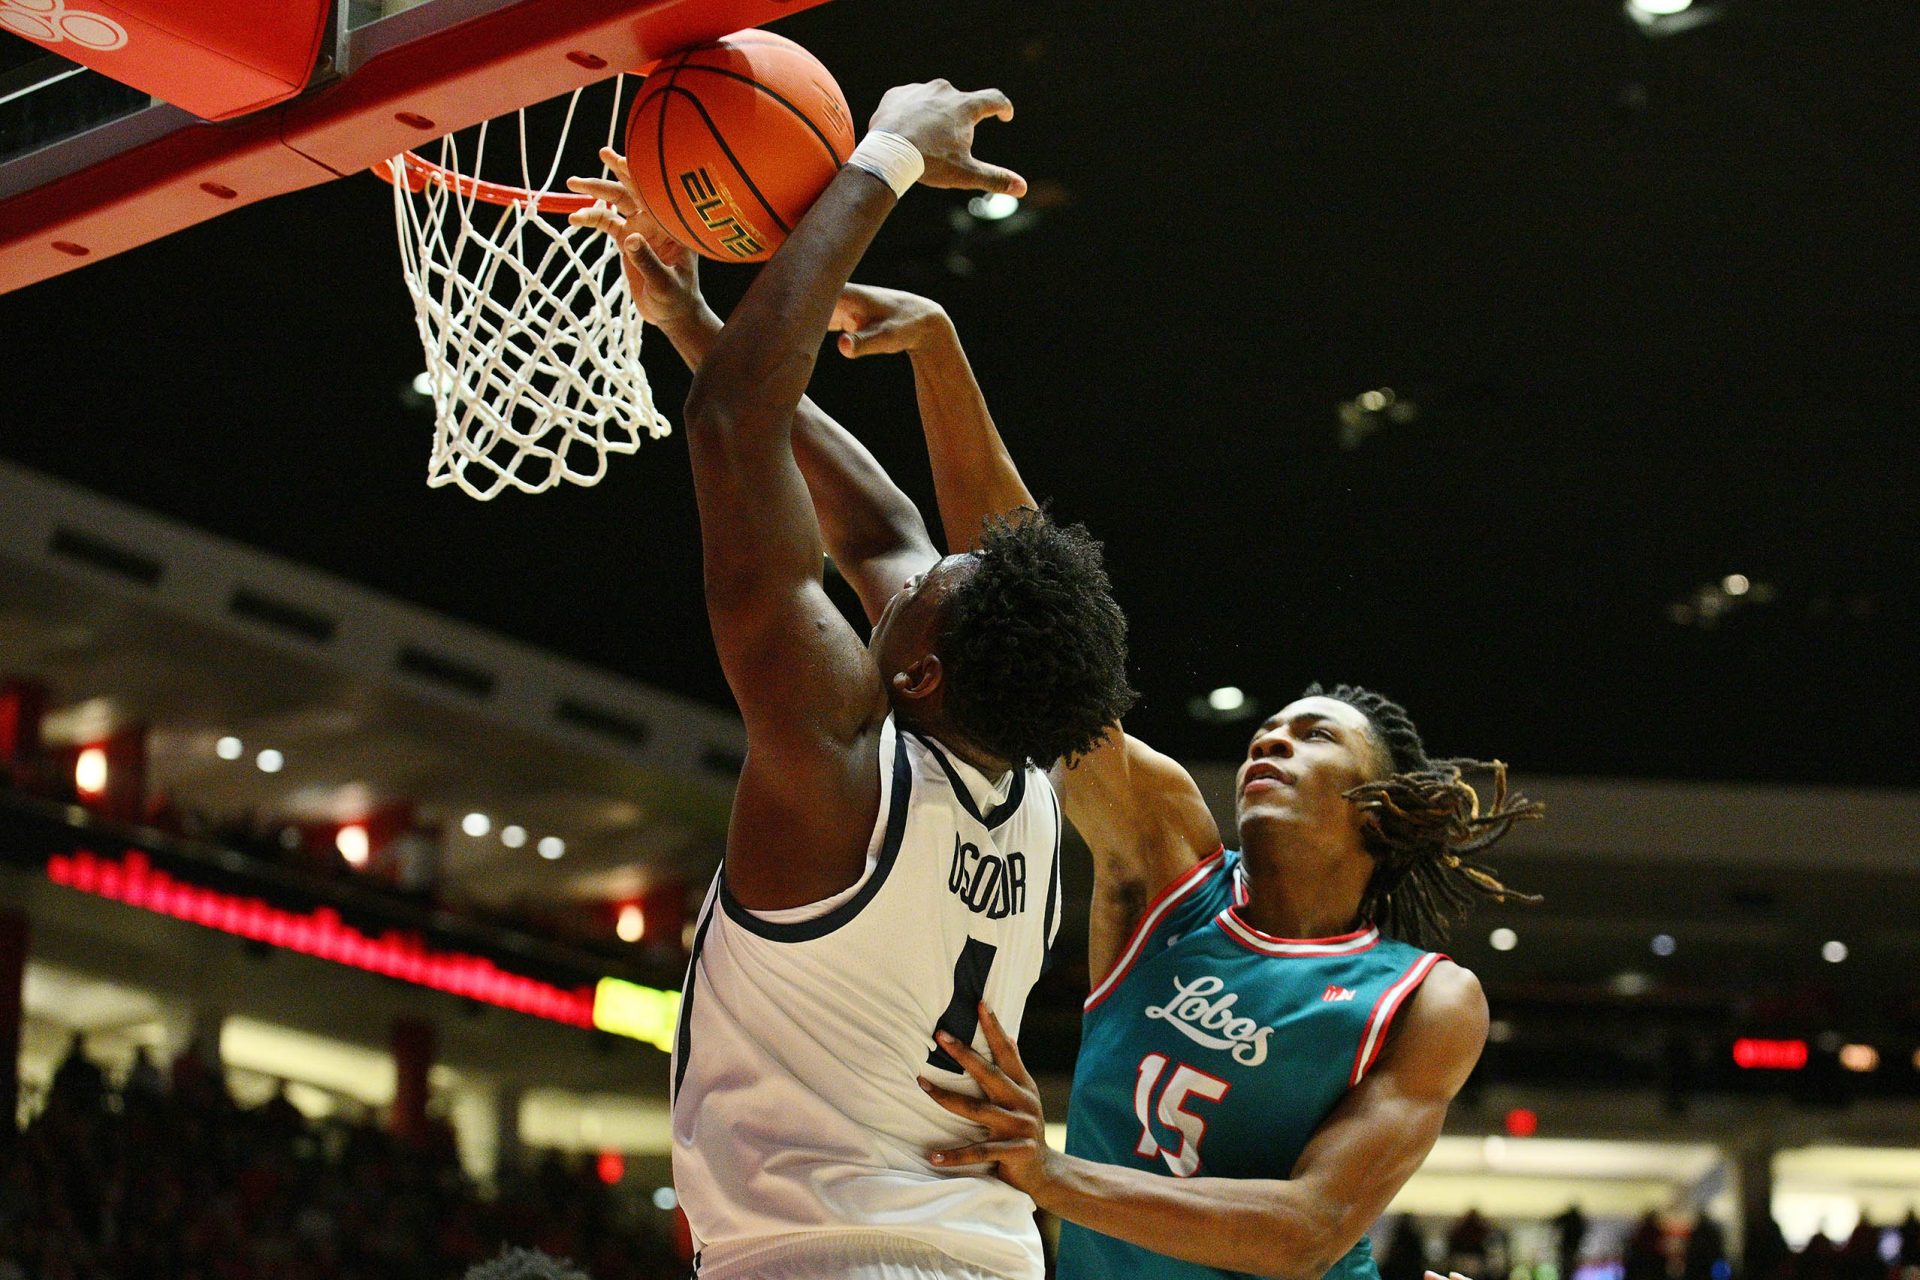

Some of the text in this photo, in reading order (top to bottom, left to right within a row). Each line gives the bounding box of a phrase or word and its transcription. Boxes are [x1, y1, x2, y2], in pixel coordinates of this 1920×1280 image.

[680, 167, 764, 258] ELITE
[926, 934, 997, 1075] 1
[1145, 976, 1274, 1066] Lobos
[1134, 1052, 1232, 1178] 15
